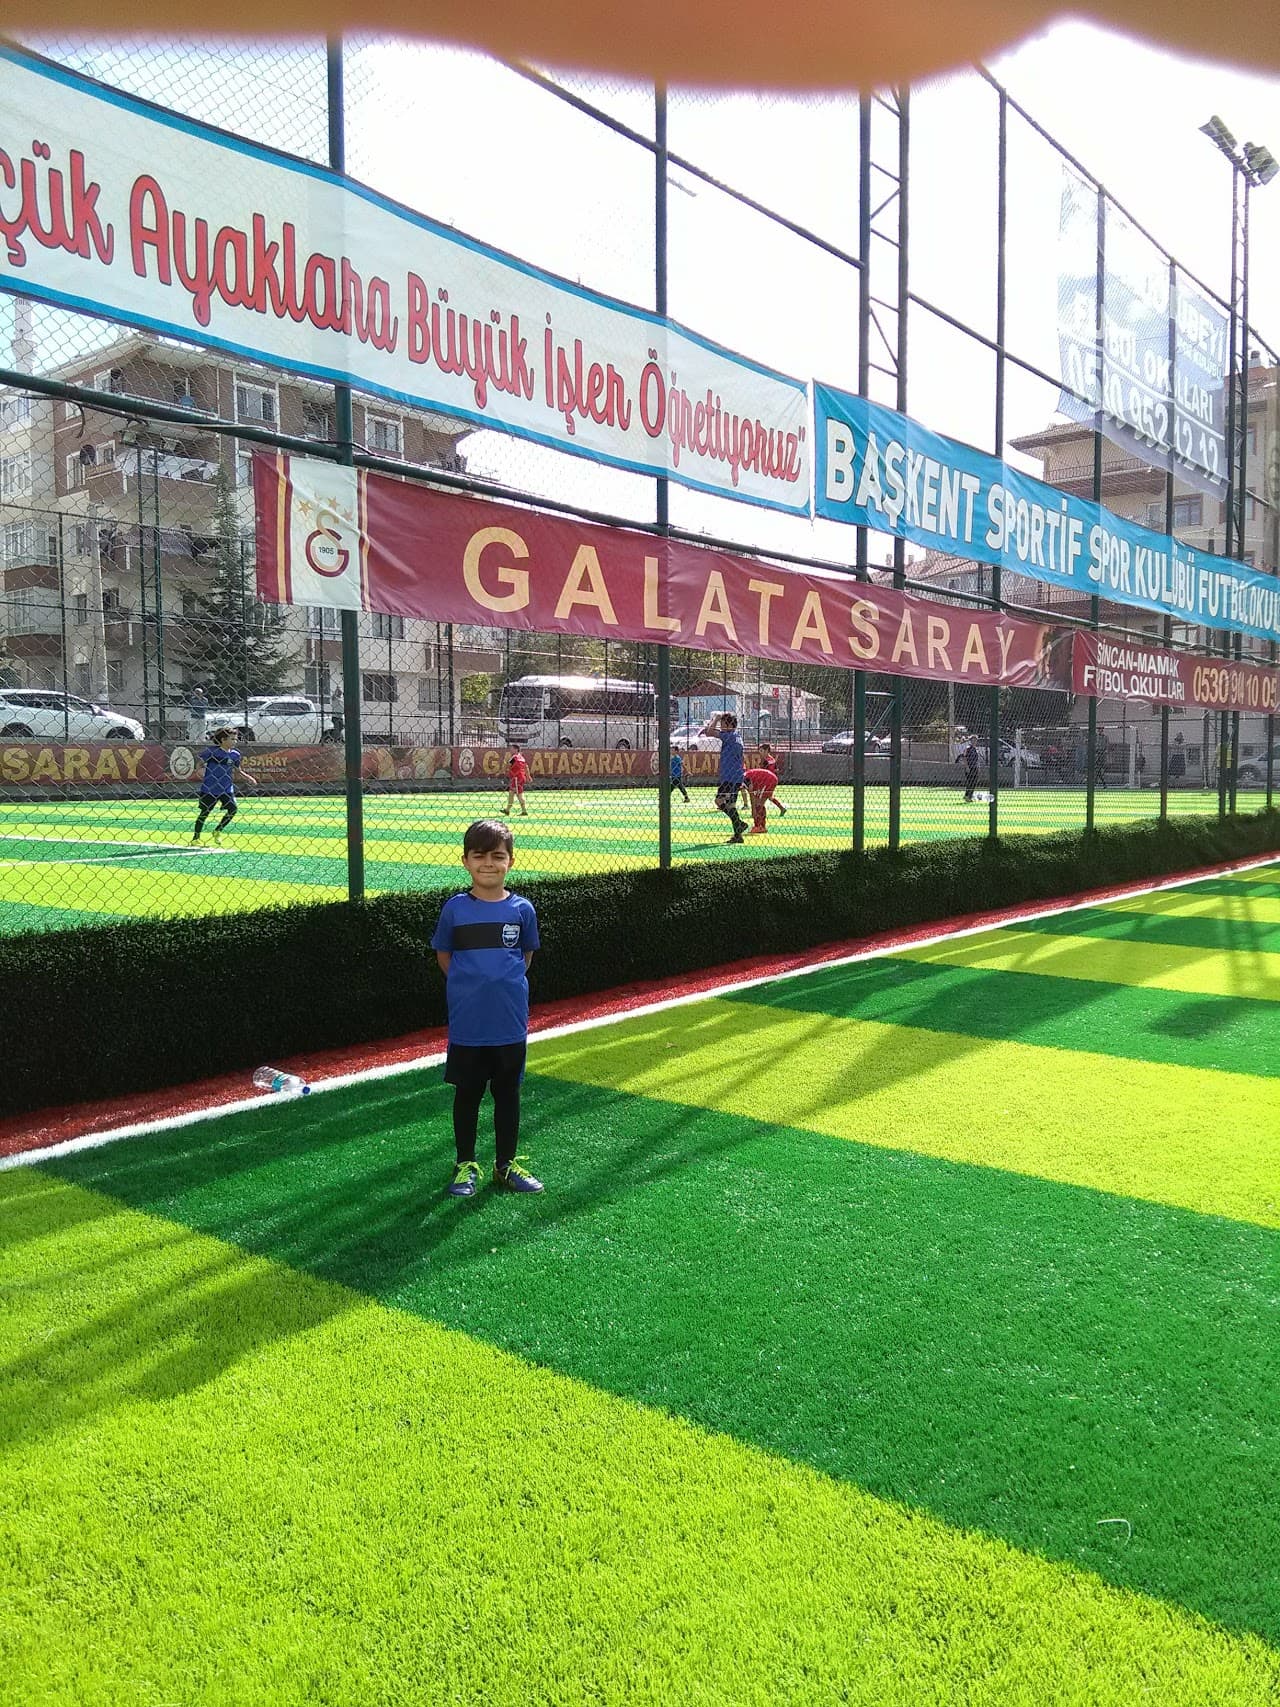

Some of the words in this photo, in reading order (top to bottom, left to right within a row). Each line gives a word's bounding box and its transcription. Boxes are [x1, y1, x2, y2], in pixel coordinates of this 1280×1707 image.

[129, 174, 399, 353] Ayaklara
[407, 271, 535, 409] Büyük
[544, 312, 631, 436] İşler
[825, 417, 981, 544] BAŞKENT
[985, 482, 1084, 576] SPORTİF
[1087, 524, 1133, 595] SPOR
[462, 526, 1016, 677] GALATASARAY
[1130, 674, 1185, 701] OKULLARI
[1193, 665, 1229, 704] 0530
[1246, 674, 1259, 707] 10
[1, 748, 147, 781] SARAY
[482, 751, 637, 777] GATASARAY
